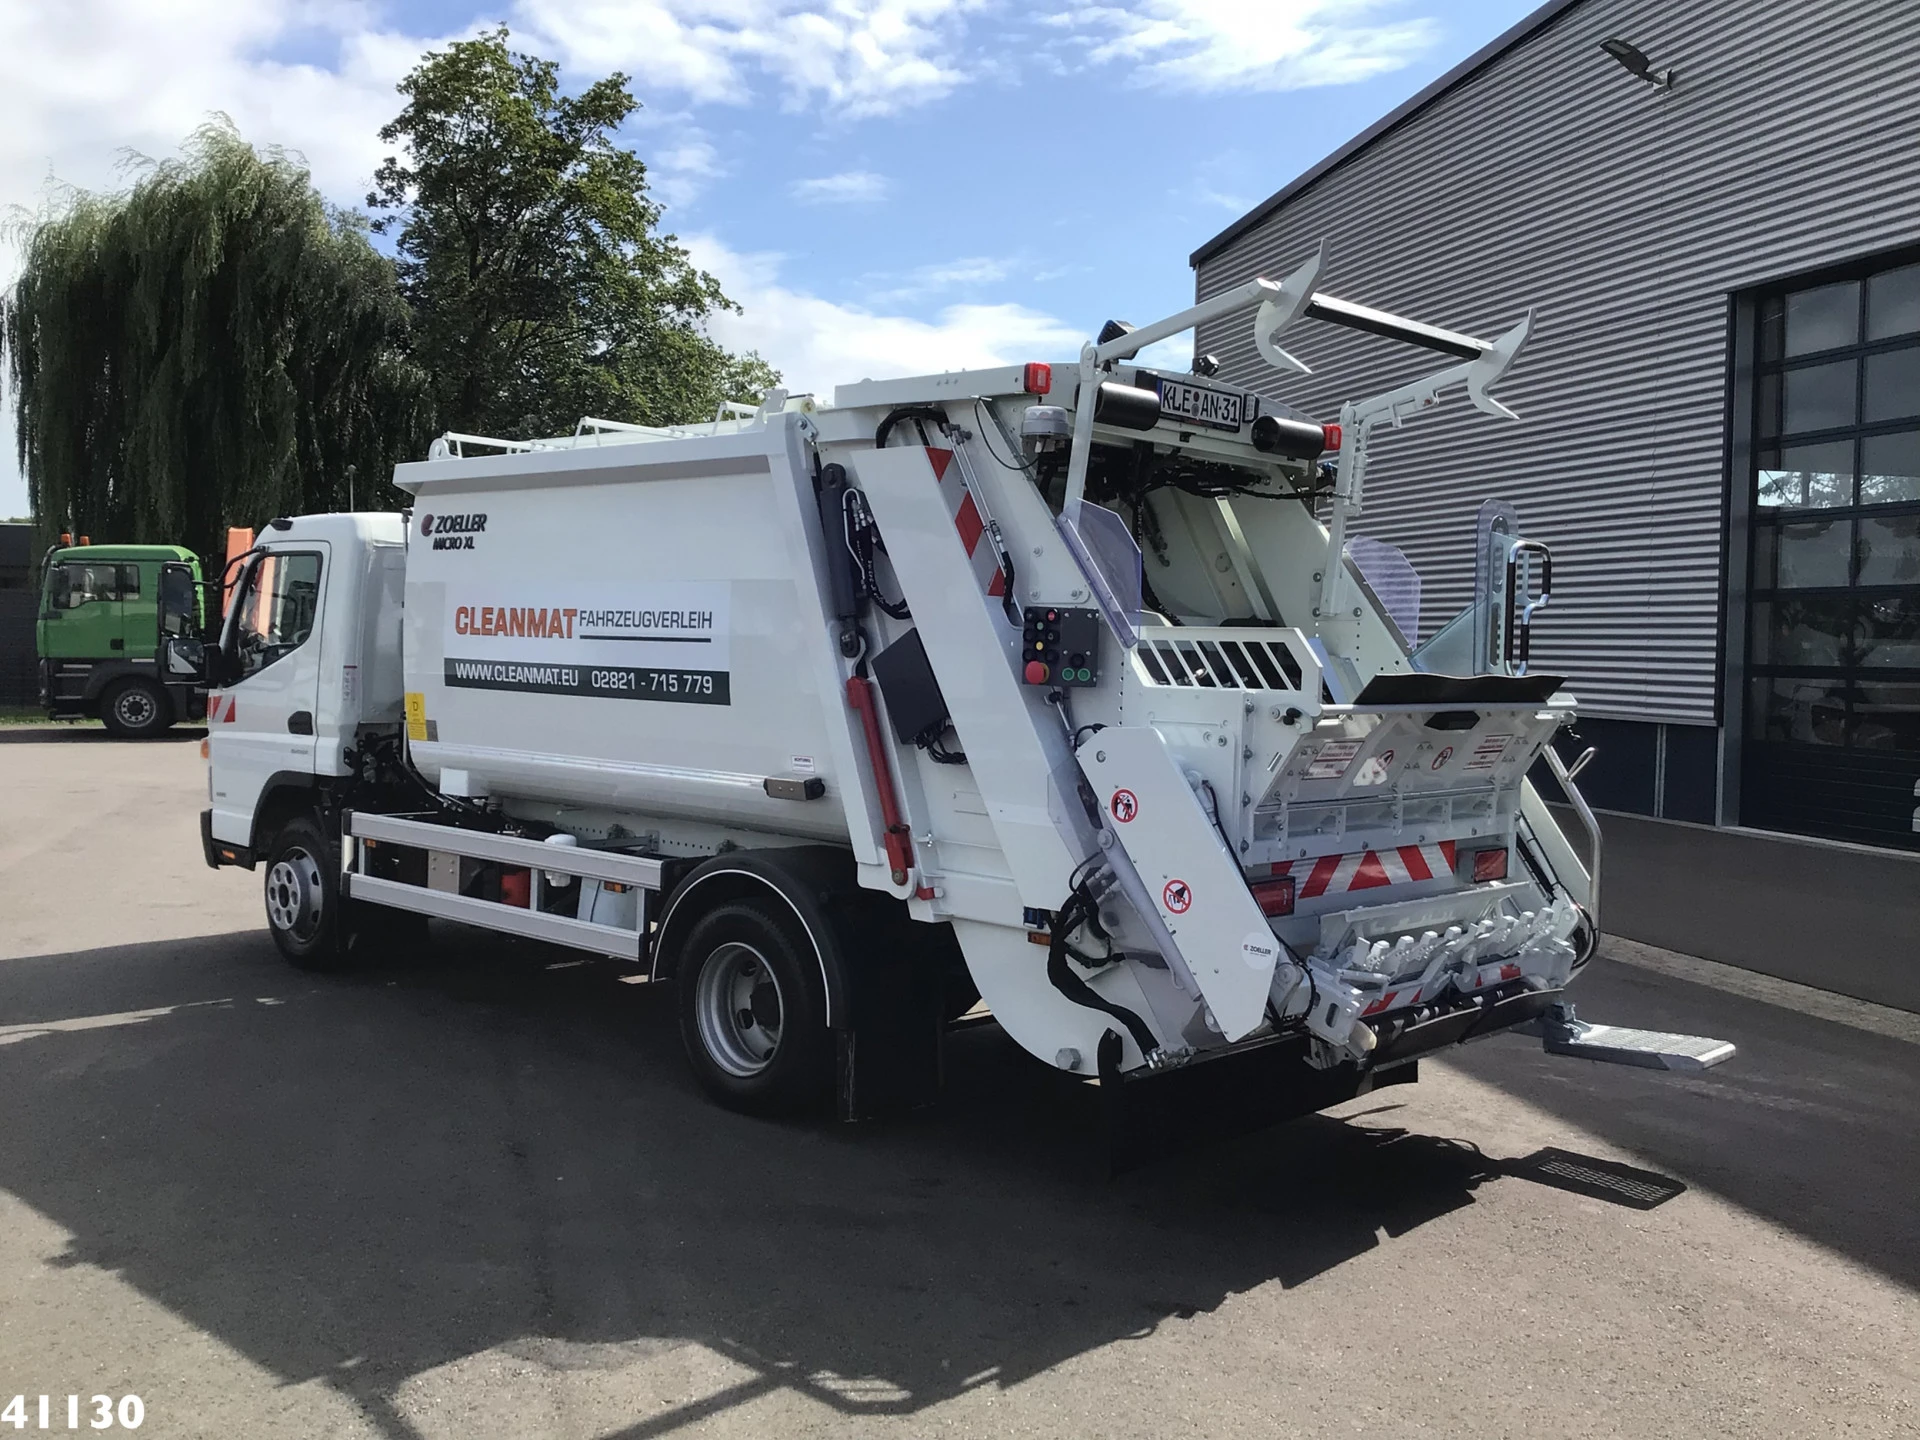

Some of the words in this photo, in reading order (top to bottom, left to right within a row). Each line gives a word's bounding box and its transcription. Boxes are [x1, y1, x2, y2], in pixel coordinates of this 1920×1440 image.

[434, 513, 487, 533] ZOELLER
[432, 535, 463, 550] MICRO
[463, 535, 475, 550] XL
[455, 606, 578, 639] CLEANMAT
[579, 610, 713, 629] FAHRZEUGVERLEIH
[455, 662, 579, 687] WWW.CLEANMAT.EU
[591, 670, 636, 690] 02821
[649, 673, 678, 692] 715
[683, 675, 713, 695] 779
[1249, 945, 1271, 955] ZOELLER
